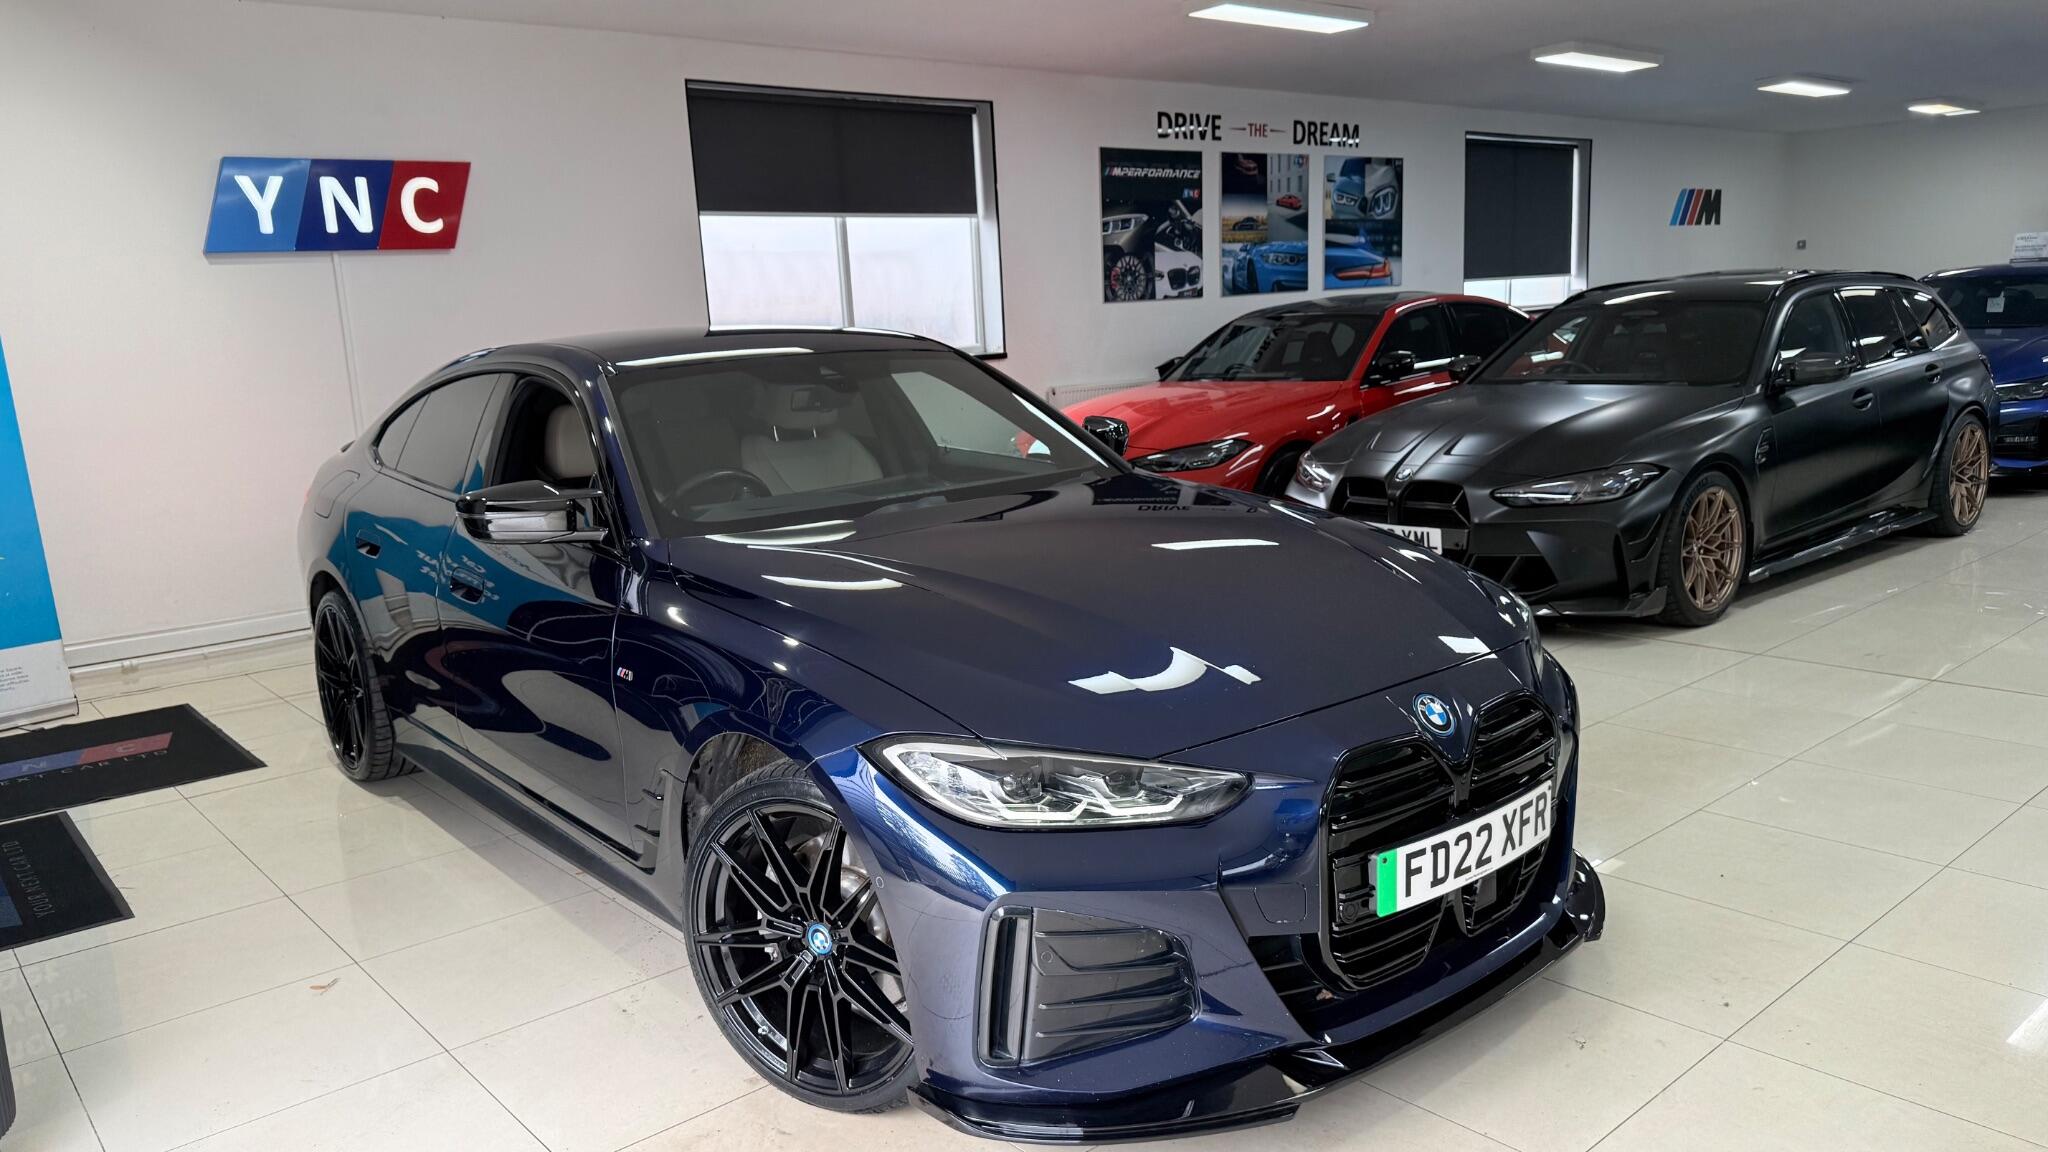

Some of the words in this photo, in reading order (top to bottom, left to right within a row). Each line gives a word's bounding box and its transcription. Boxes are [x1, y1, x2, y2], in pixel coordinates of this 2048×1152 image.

[1157, 111, 1222, 141] DRIVE
[1248, 123, 1269, 138] THE
[1293, 120, 1360, 148] DREAM
[234, 175, 444, 235] YNC
[1405, 822, 1493, 898] FD22
[1501, 791, 1548, 857] XFR
